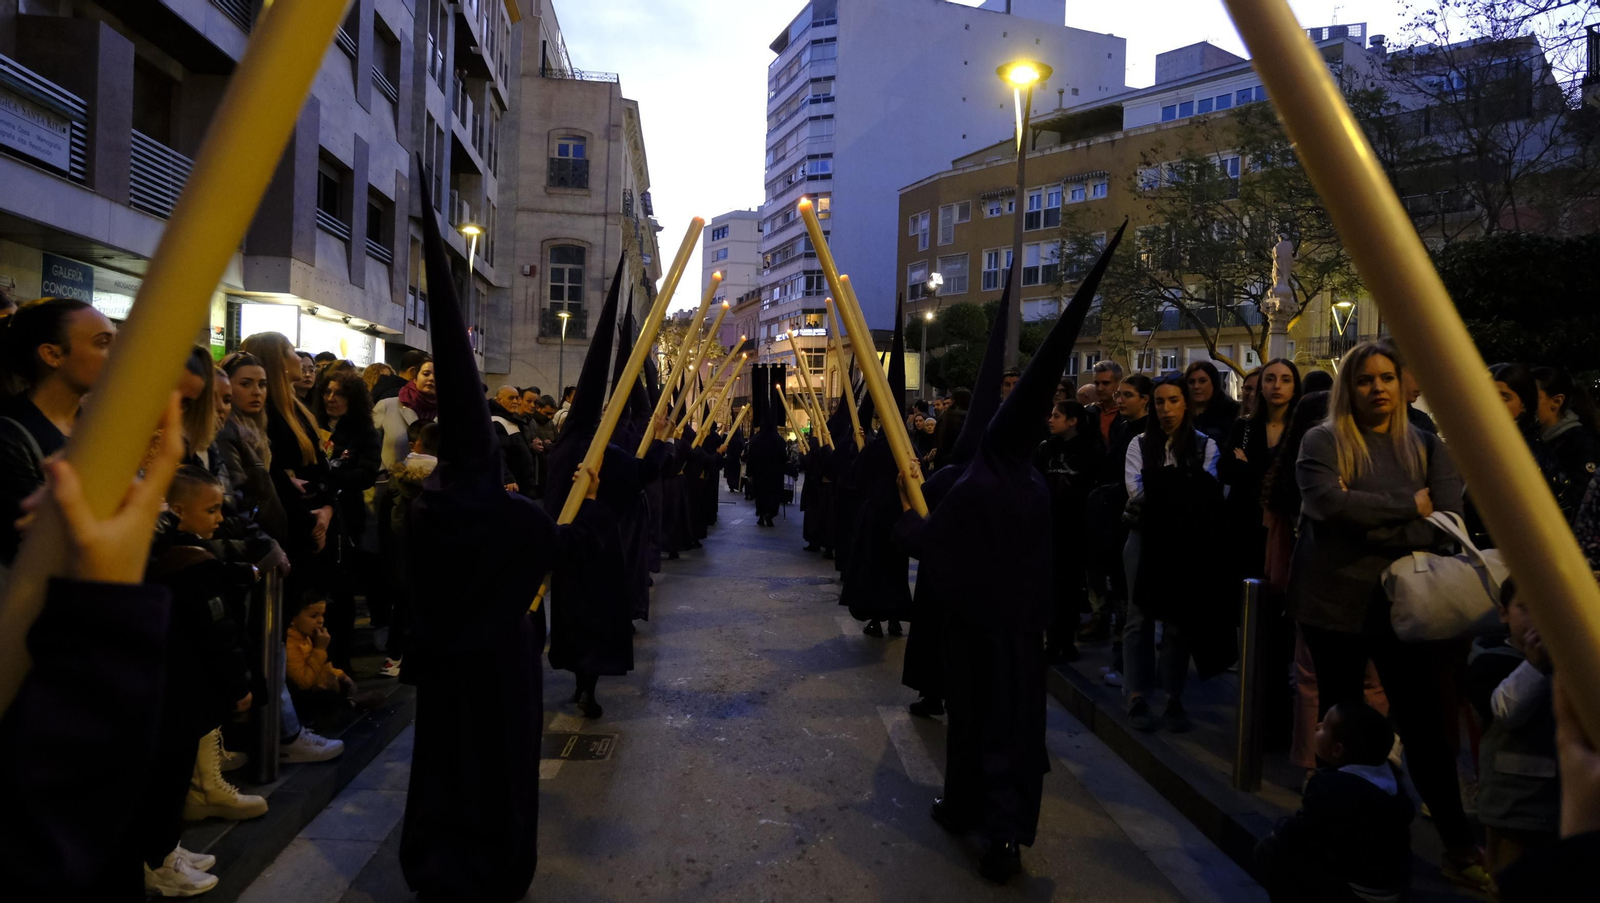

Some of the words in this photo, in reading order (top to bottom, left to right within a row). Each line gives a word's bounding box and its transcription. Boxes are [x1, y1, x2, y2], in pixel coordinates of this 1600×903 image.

[21, 104, 45, 126] SANTA
[46, 117, 63, 134] RITA
[52, 264, 83, 283] GALERÍA
[43, 280, 90, 302] CONCORDIA
